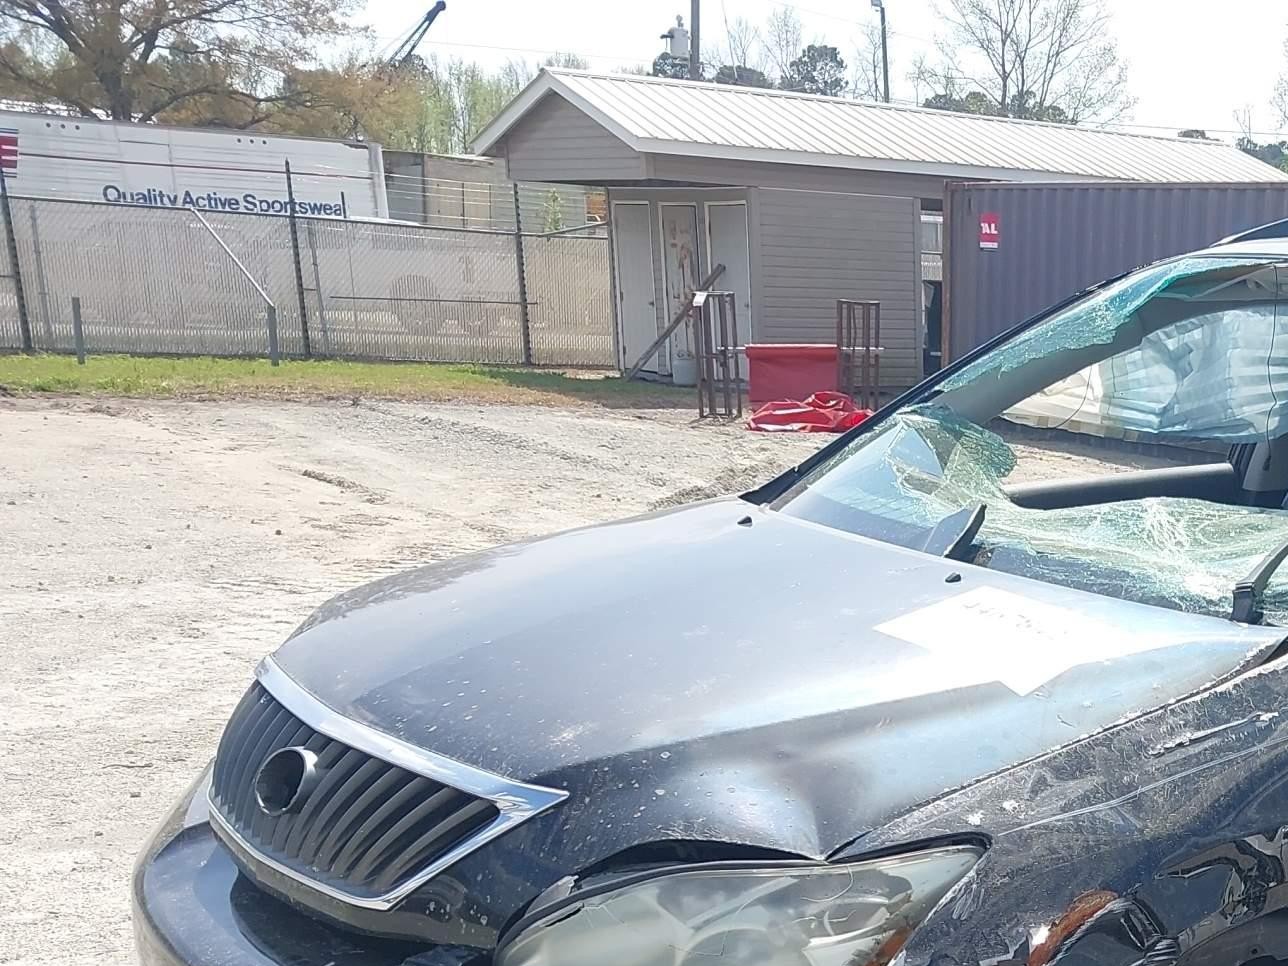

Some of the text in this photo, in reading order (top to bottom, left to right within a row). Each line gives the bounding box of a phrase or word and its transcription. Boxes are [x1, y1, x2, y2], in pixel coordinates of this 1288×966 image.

[103, 184, 346, 217] Quality Active Sportswea
